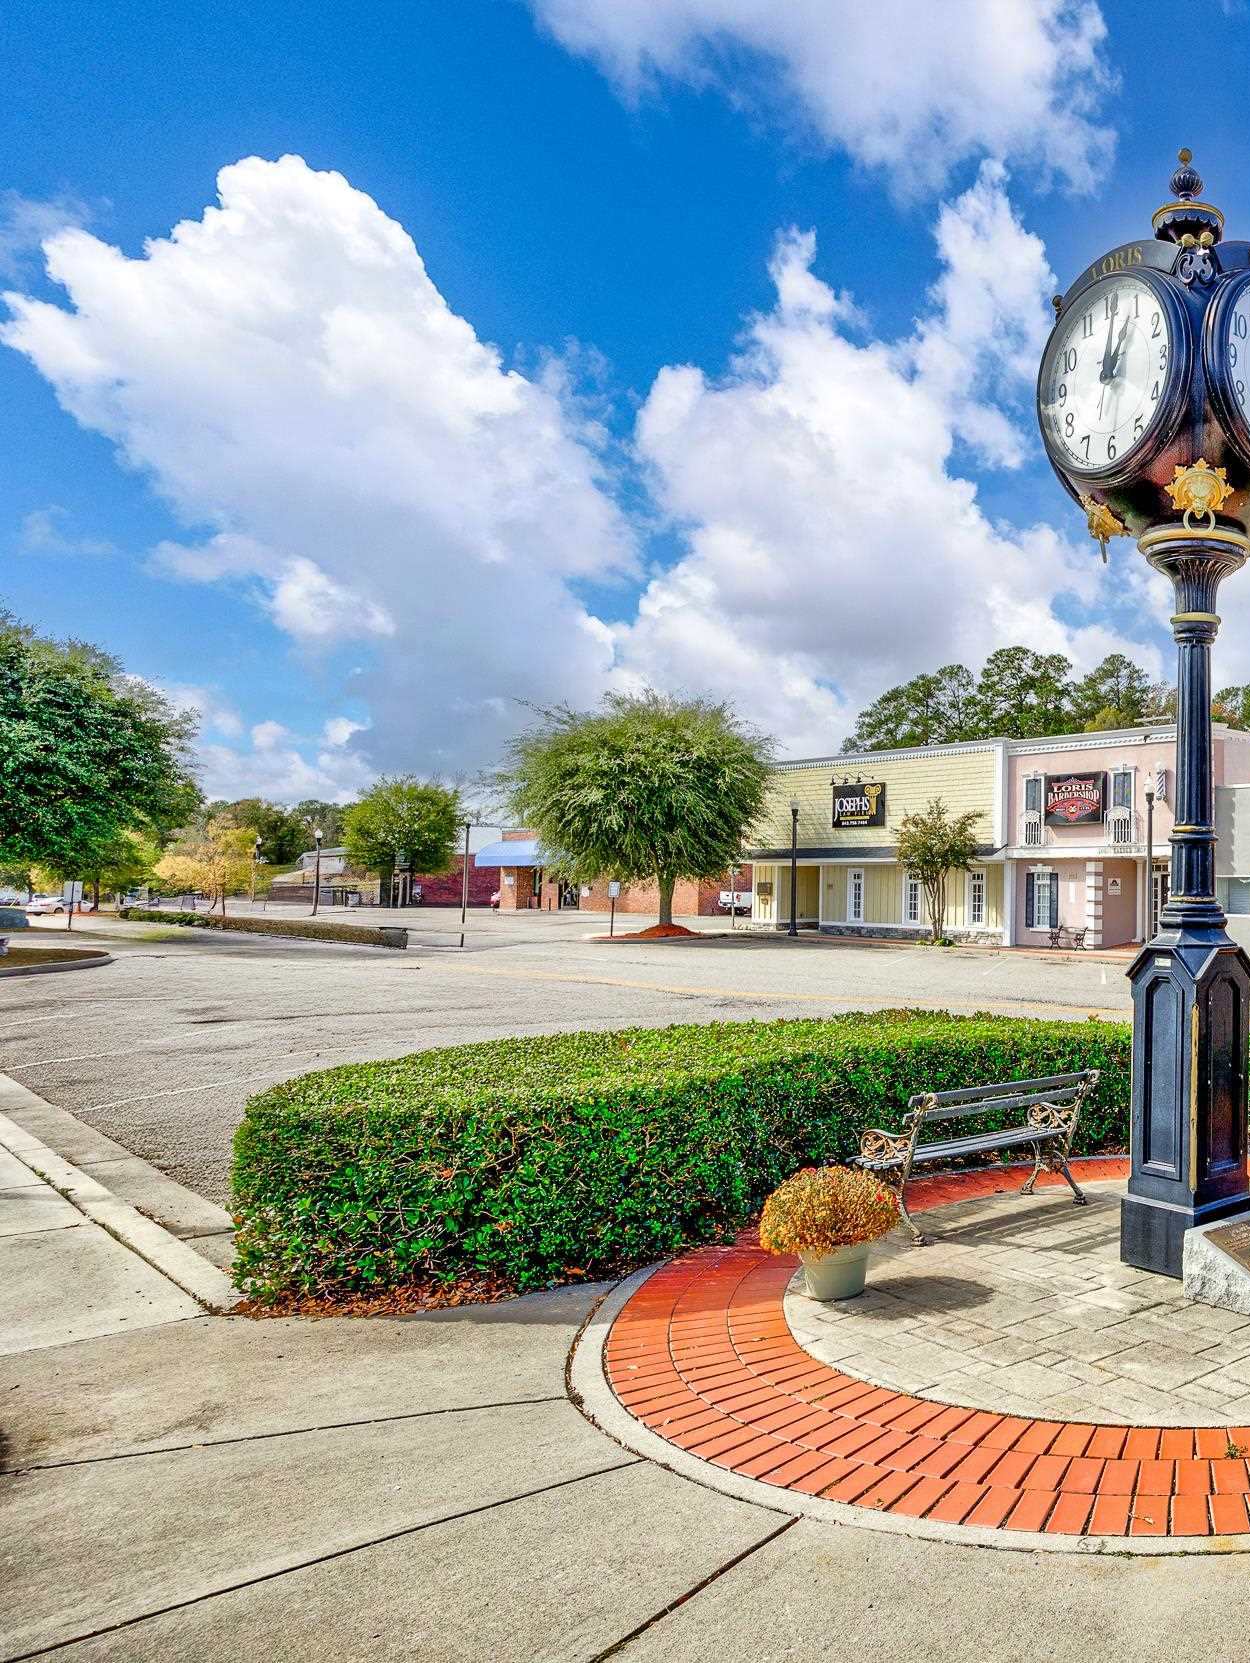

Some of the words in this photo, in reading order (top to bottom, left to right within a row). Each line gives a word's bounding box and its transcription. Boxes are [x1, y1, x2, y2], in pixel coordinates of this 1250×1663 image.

[1089, 246, 1143, 281] LORIS
[1132, 293, 1141, 319] 1
[1081, 312, 1094, 339] 11
[1151, 311, 1161, 340] 2
[1233, 311, 1247, 340] 10
[1063, 347, 1077, 375] 10
[1159, 344, 1168, 371] 3
[1228, 342, 1238, 368] 9
[1058, 383, 1068, 408] 9
[1150, 380, 1160, 401] 4
[1236, 380, 1246, 406] 8
[1065, 412, 1075, 438] 8
[1080, 434, 1091, 460] 7
[1107, 435, 1117, 460] 6
[1047, 789, 1099, 806] BARBERSHOP
[1053, 783, 1093, 792] LORIS
